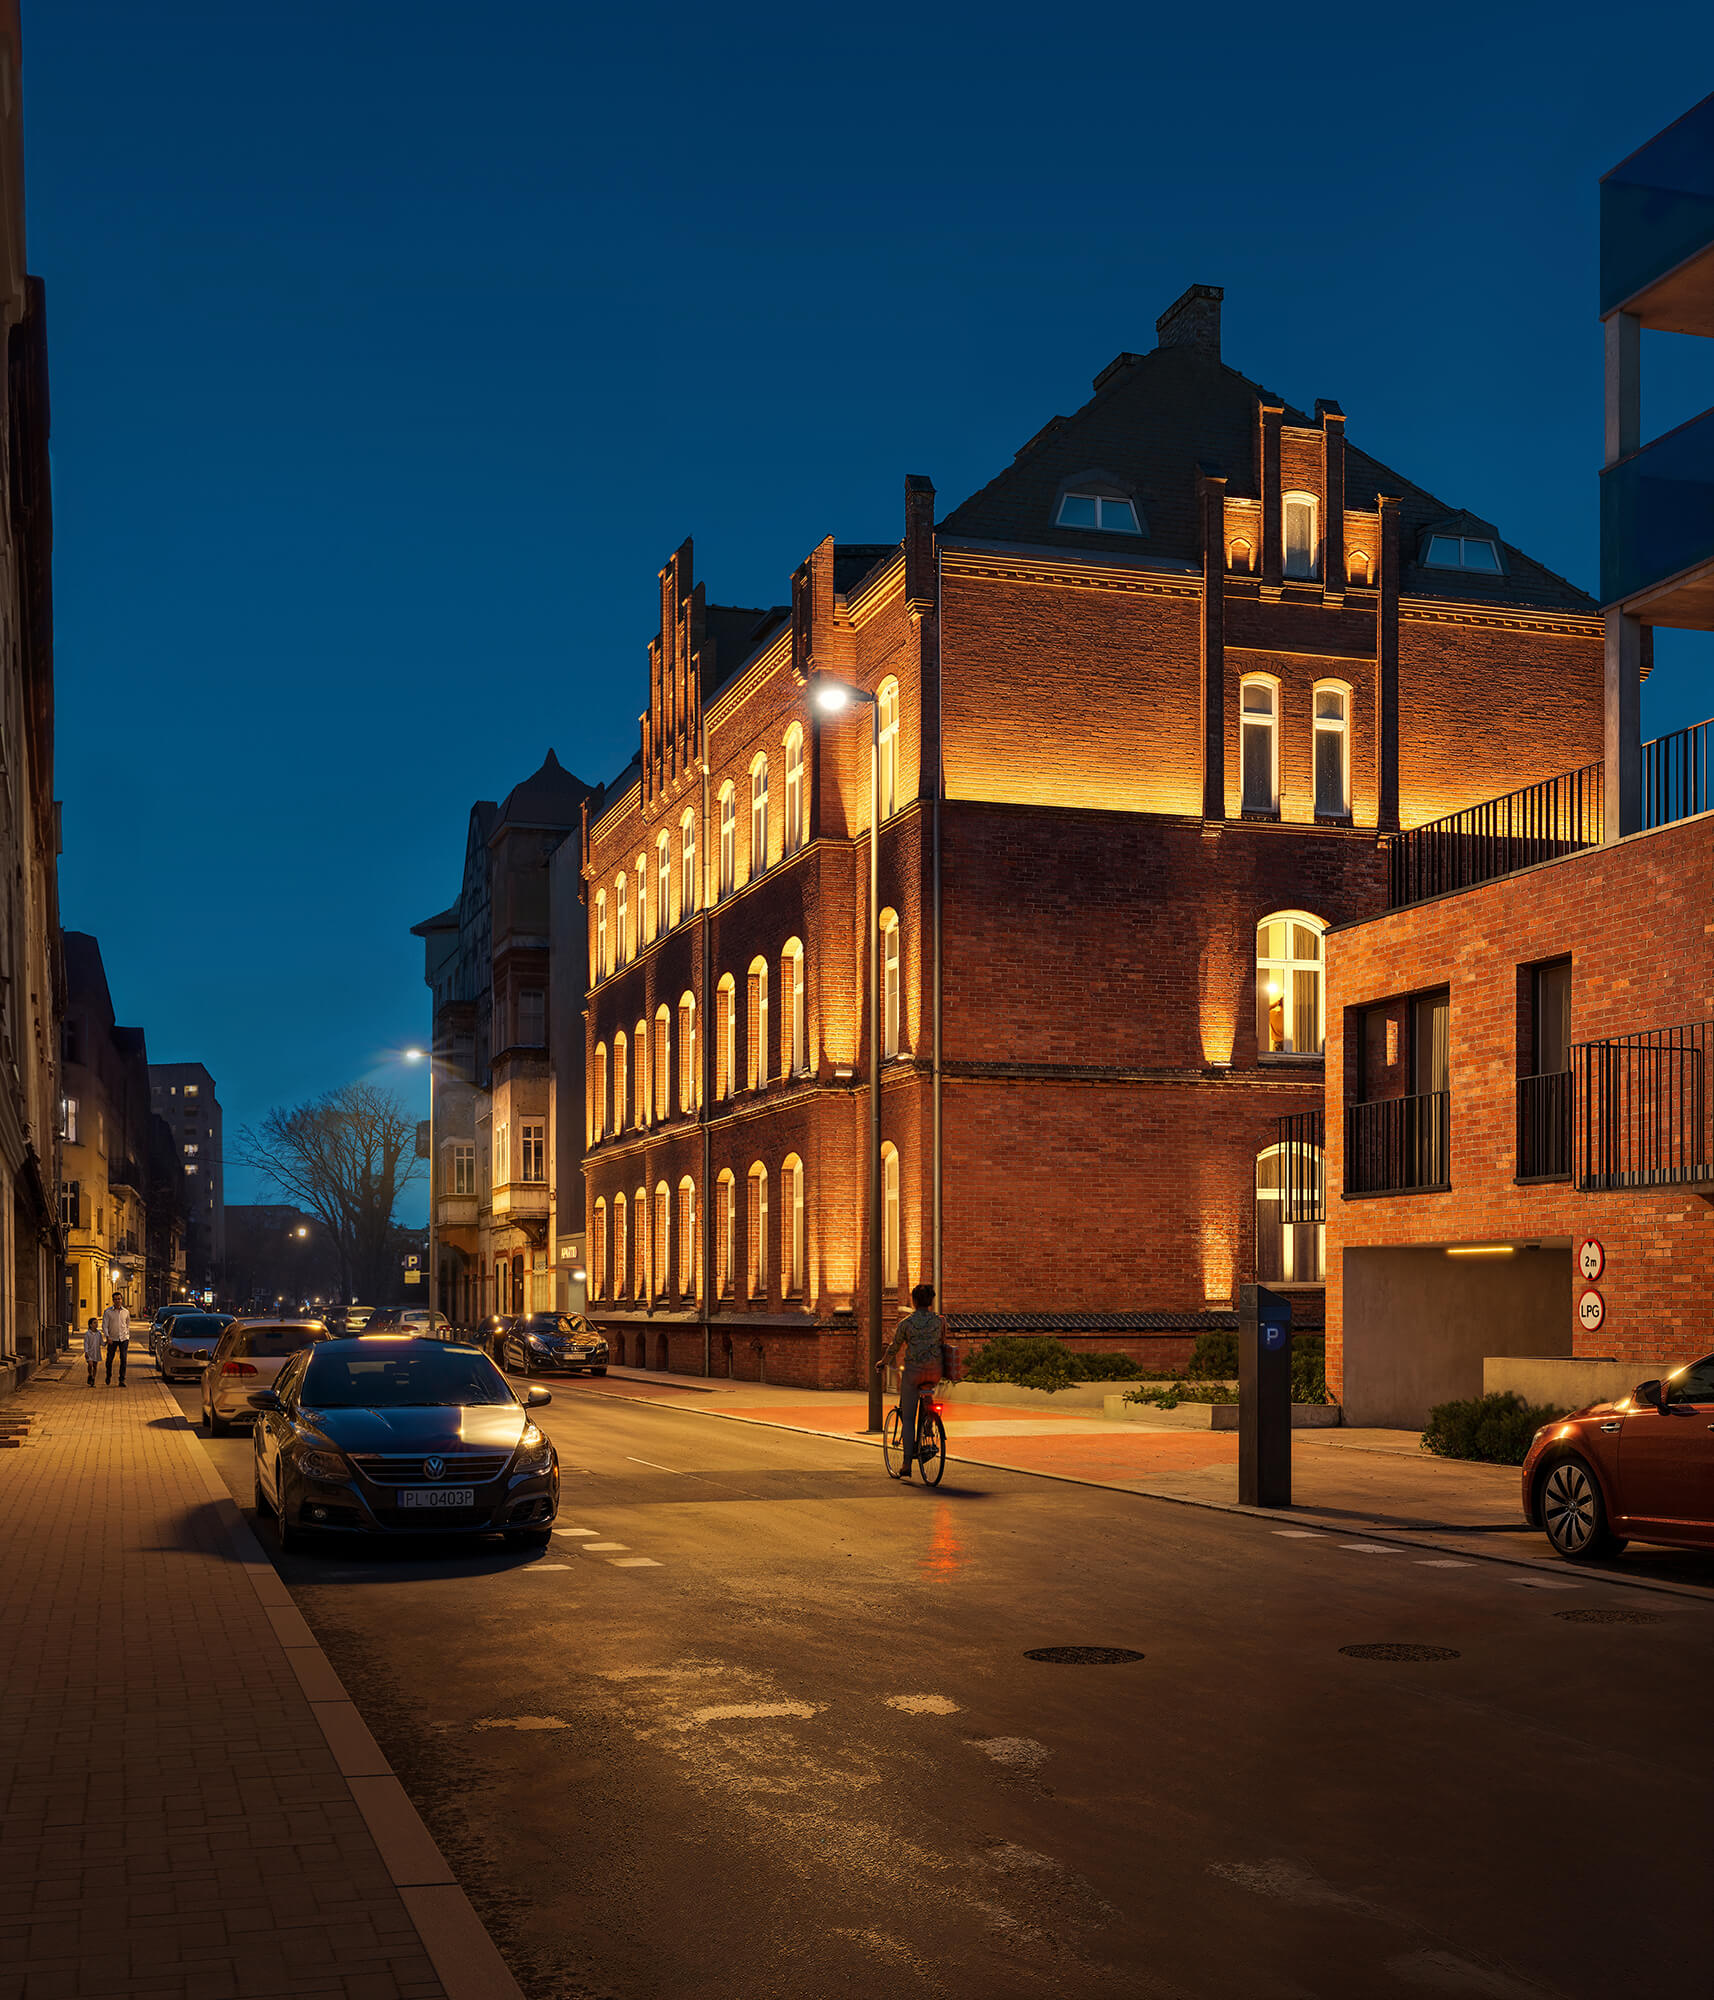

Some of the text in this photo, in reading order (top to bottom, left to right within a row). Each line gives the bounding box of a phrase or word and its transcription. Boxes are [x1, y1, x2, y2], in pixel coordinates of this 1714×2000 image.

[408, 1256, 418, 1267] P
[1581, 1304, 1600, 1318] LPG
[1267, 1328, 1279, 1344] P
[406, 1491, 473, 1506] PL 0403P
